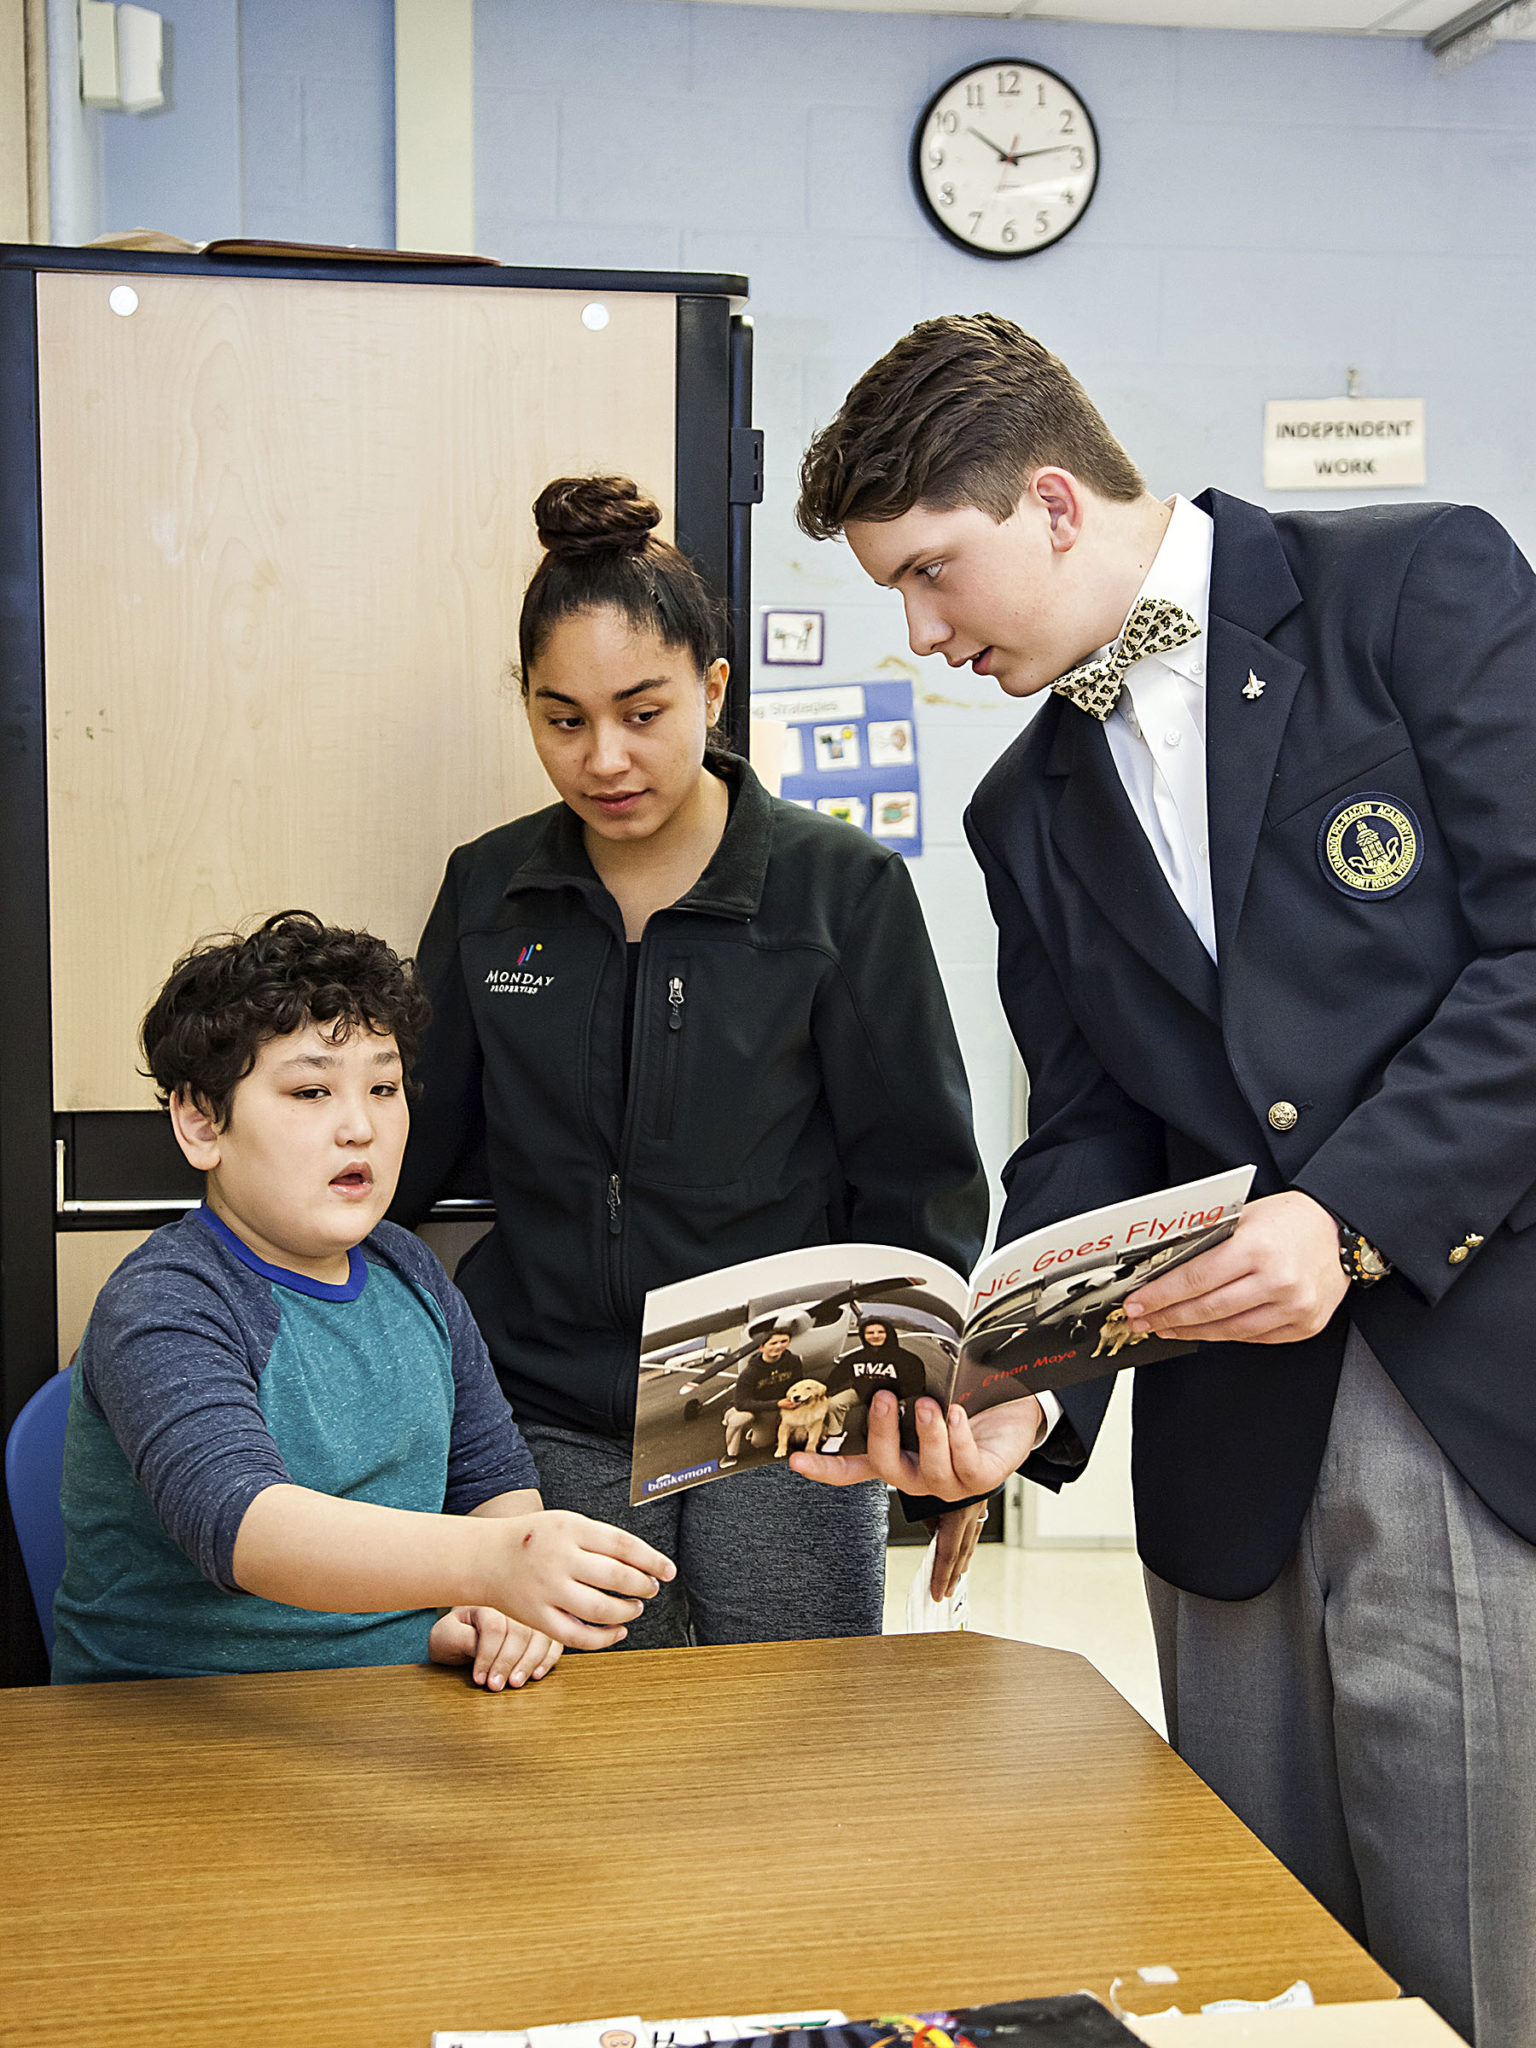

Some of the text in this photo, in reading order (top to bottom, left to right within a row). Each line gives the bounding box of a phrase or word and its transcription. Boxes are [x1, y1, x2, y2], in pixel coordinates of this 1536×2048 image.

[996, 71, 1020, 95] 12
[1038, 83, 1046, 106] 1
[966, 84, 984, 106] 11
[934, 111, 958, 134] 10
[1059, 109, 1073, 133] 2
[929, 149, 943, 170] 9
[1071, 146, 1084, 170] 3
[940, 182, 955, 205] 8
[968, 211, 983, 234] 7
[1002, 219, 1016, 243] 6
[1035, 210, 1049, 233] 5
[1276, 420, 1414, 438] INDEPENDENT
[1314, 458, 1378, 475] WORK
[1329, 804, 1411, 869] RANDOLPH-MACON ACADEMY
[1342, 869, 1371, 888] FRONT
[1372, 873, 1398, 889] ROYAL
[484, 970, 555, 986] MONDAY
[973, 1205, 1225, 1310] Nic Goes Flying
[982, 1364, 1028, 1387] Ethan
[647, 1465, 712, 1492] bookemon
